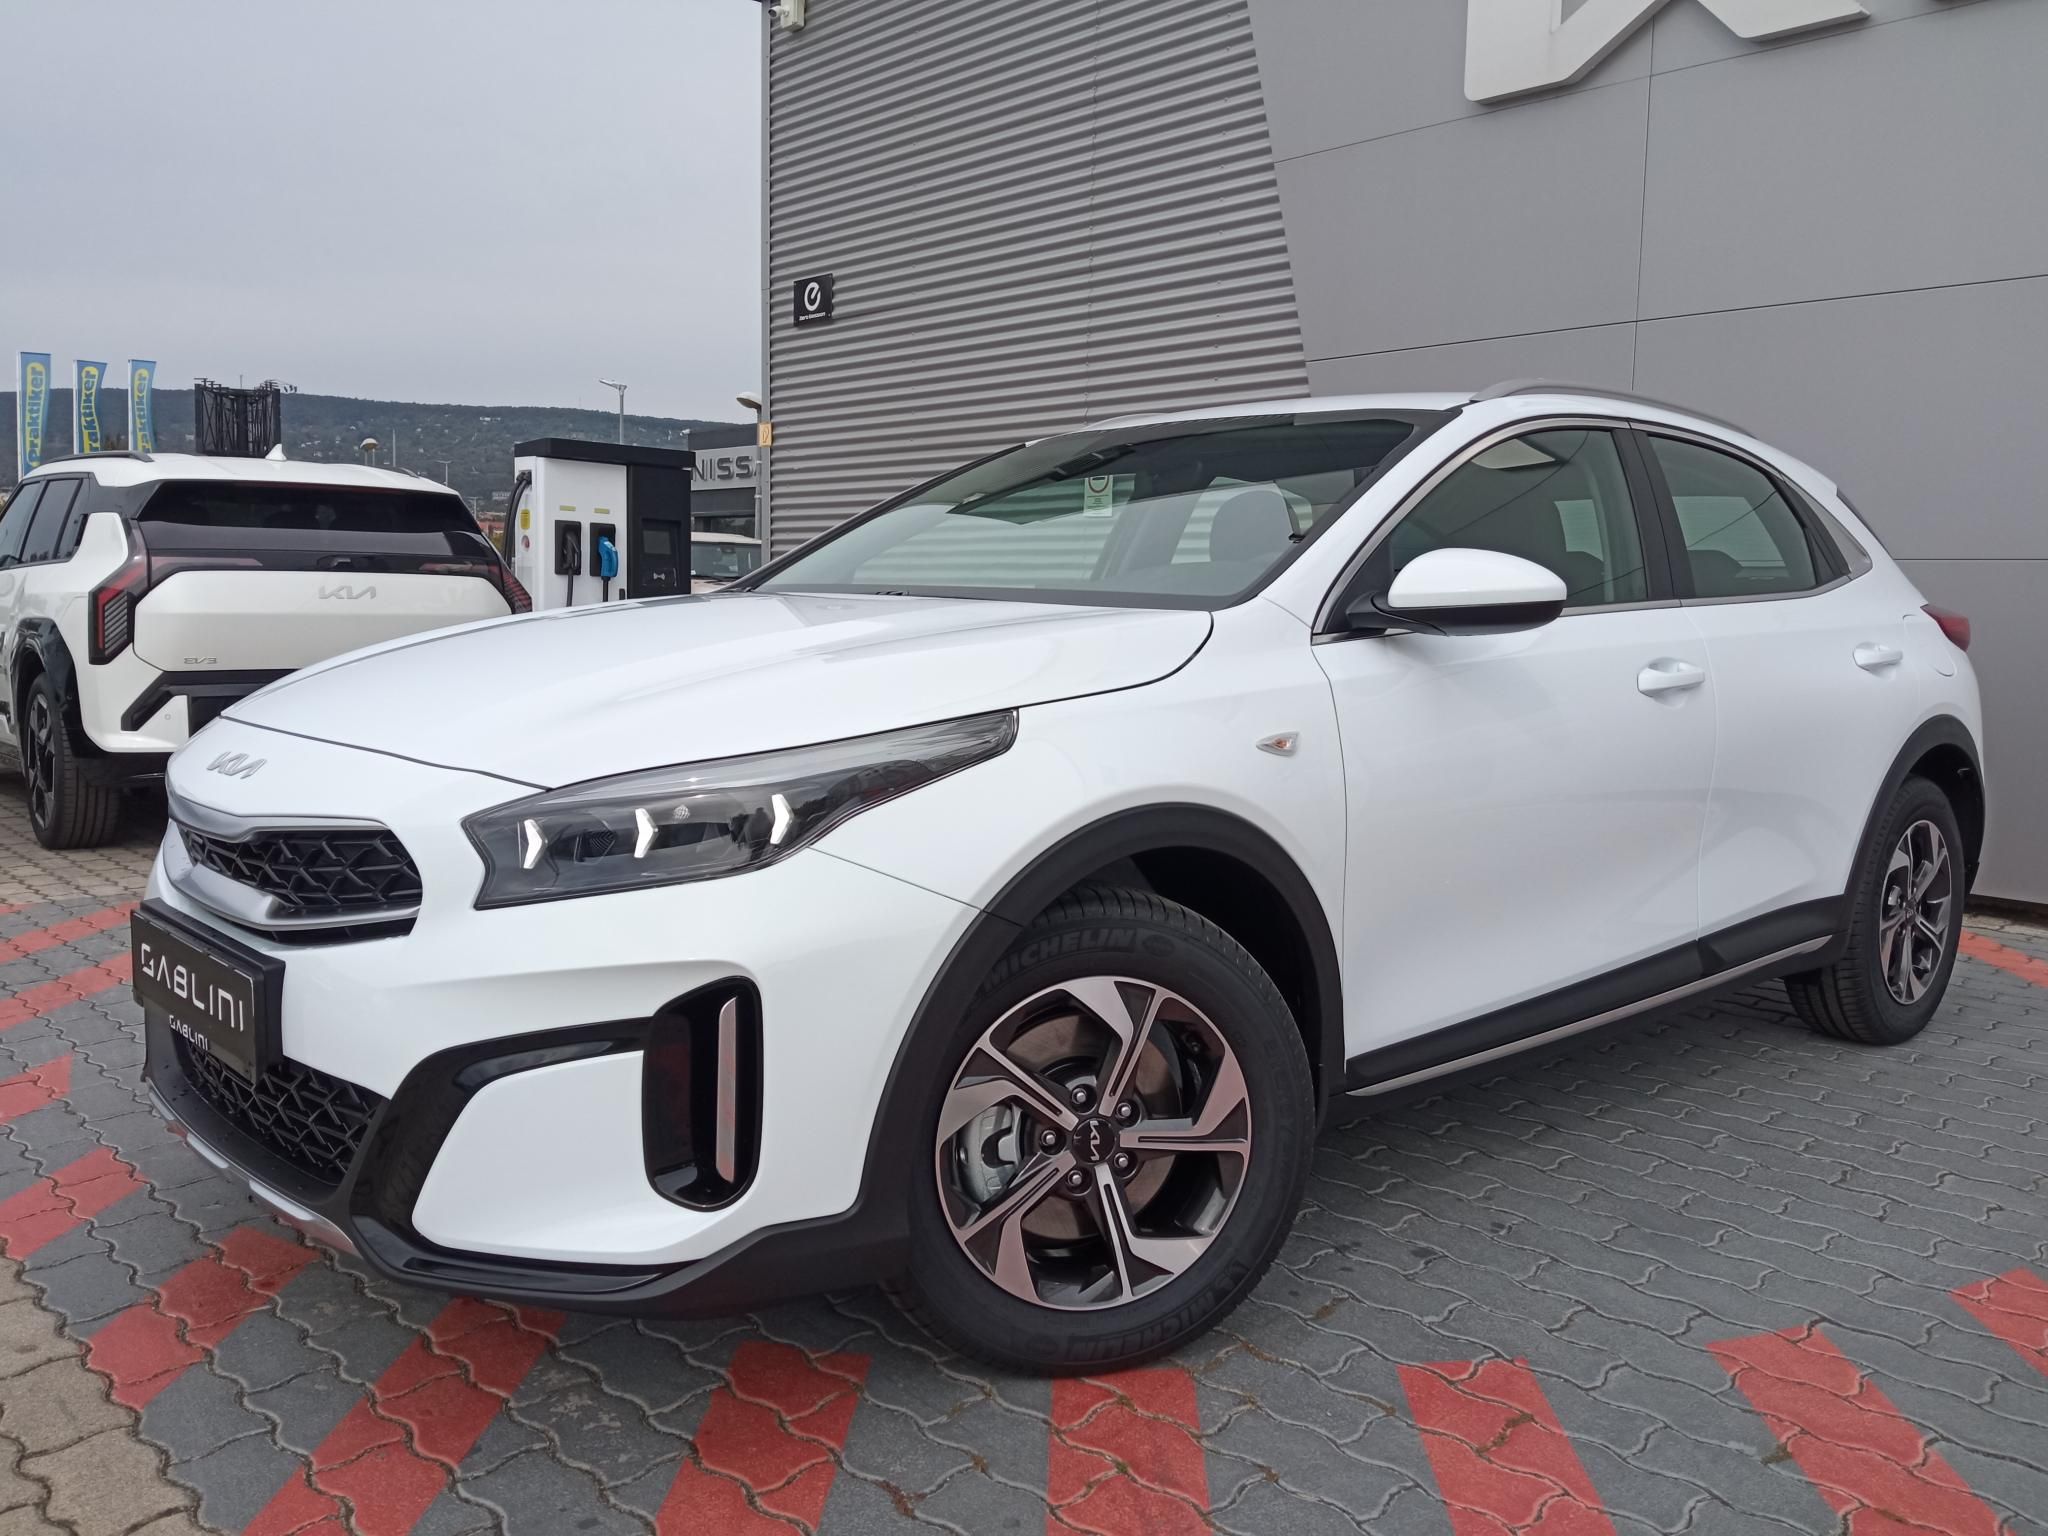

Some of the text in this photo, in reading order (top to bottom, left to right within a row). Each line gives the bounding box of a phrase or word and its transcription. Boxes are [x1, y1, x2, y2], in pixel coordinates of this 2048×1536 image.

[690, 456, 757, 482] NISS
[318, 585, 377, 600] KIA
[183, 656, 217, 665] EV3
[206, 751, 268, 780] KIA
[141, 943, 244, 1032] GABLINI
[169, 1015, 209, 1051] GABLINI
